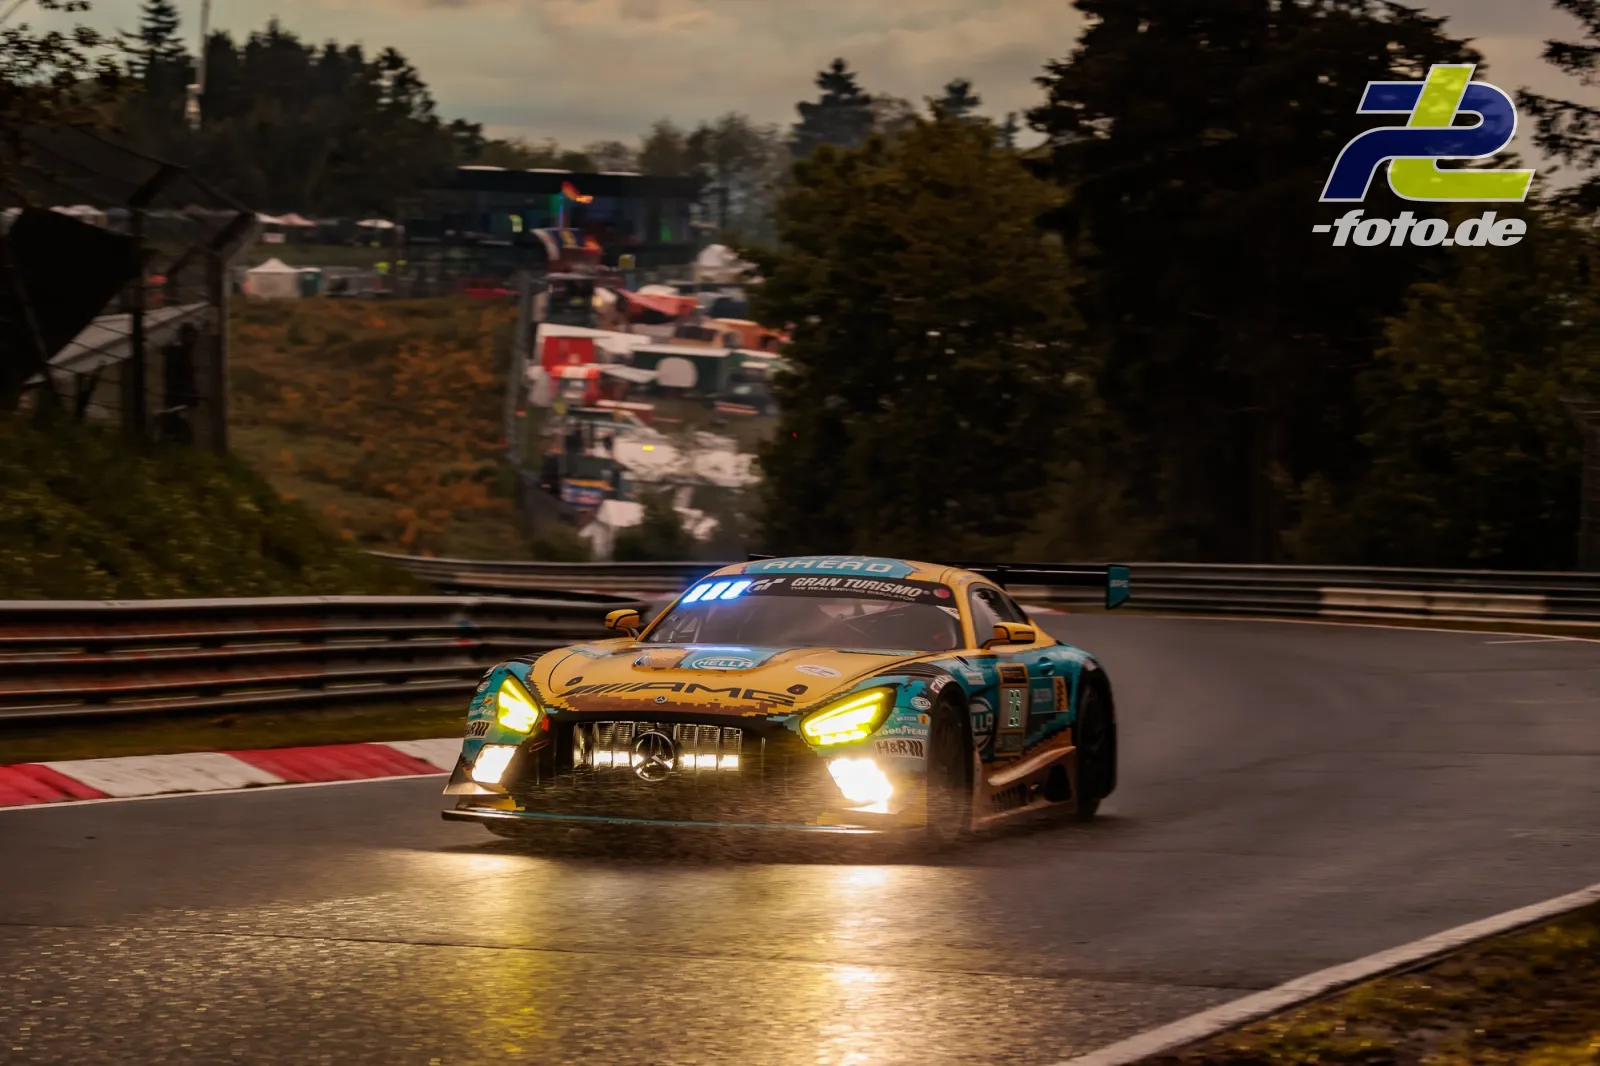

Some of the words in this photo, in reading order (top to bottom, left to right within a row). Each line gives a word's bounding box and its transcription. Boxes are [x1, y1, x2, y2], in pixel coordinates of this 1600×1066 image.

[763, 560, 894, 573] AHEAD
[791, 577, 841, 588] GRAN
[845, 578, 923, 597] TURISMO
[867, 590, 916, 601] SIMULATOR
[699, 659, 754, 668] HELLA
[626, 682, 796, 707] AMG
